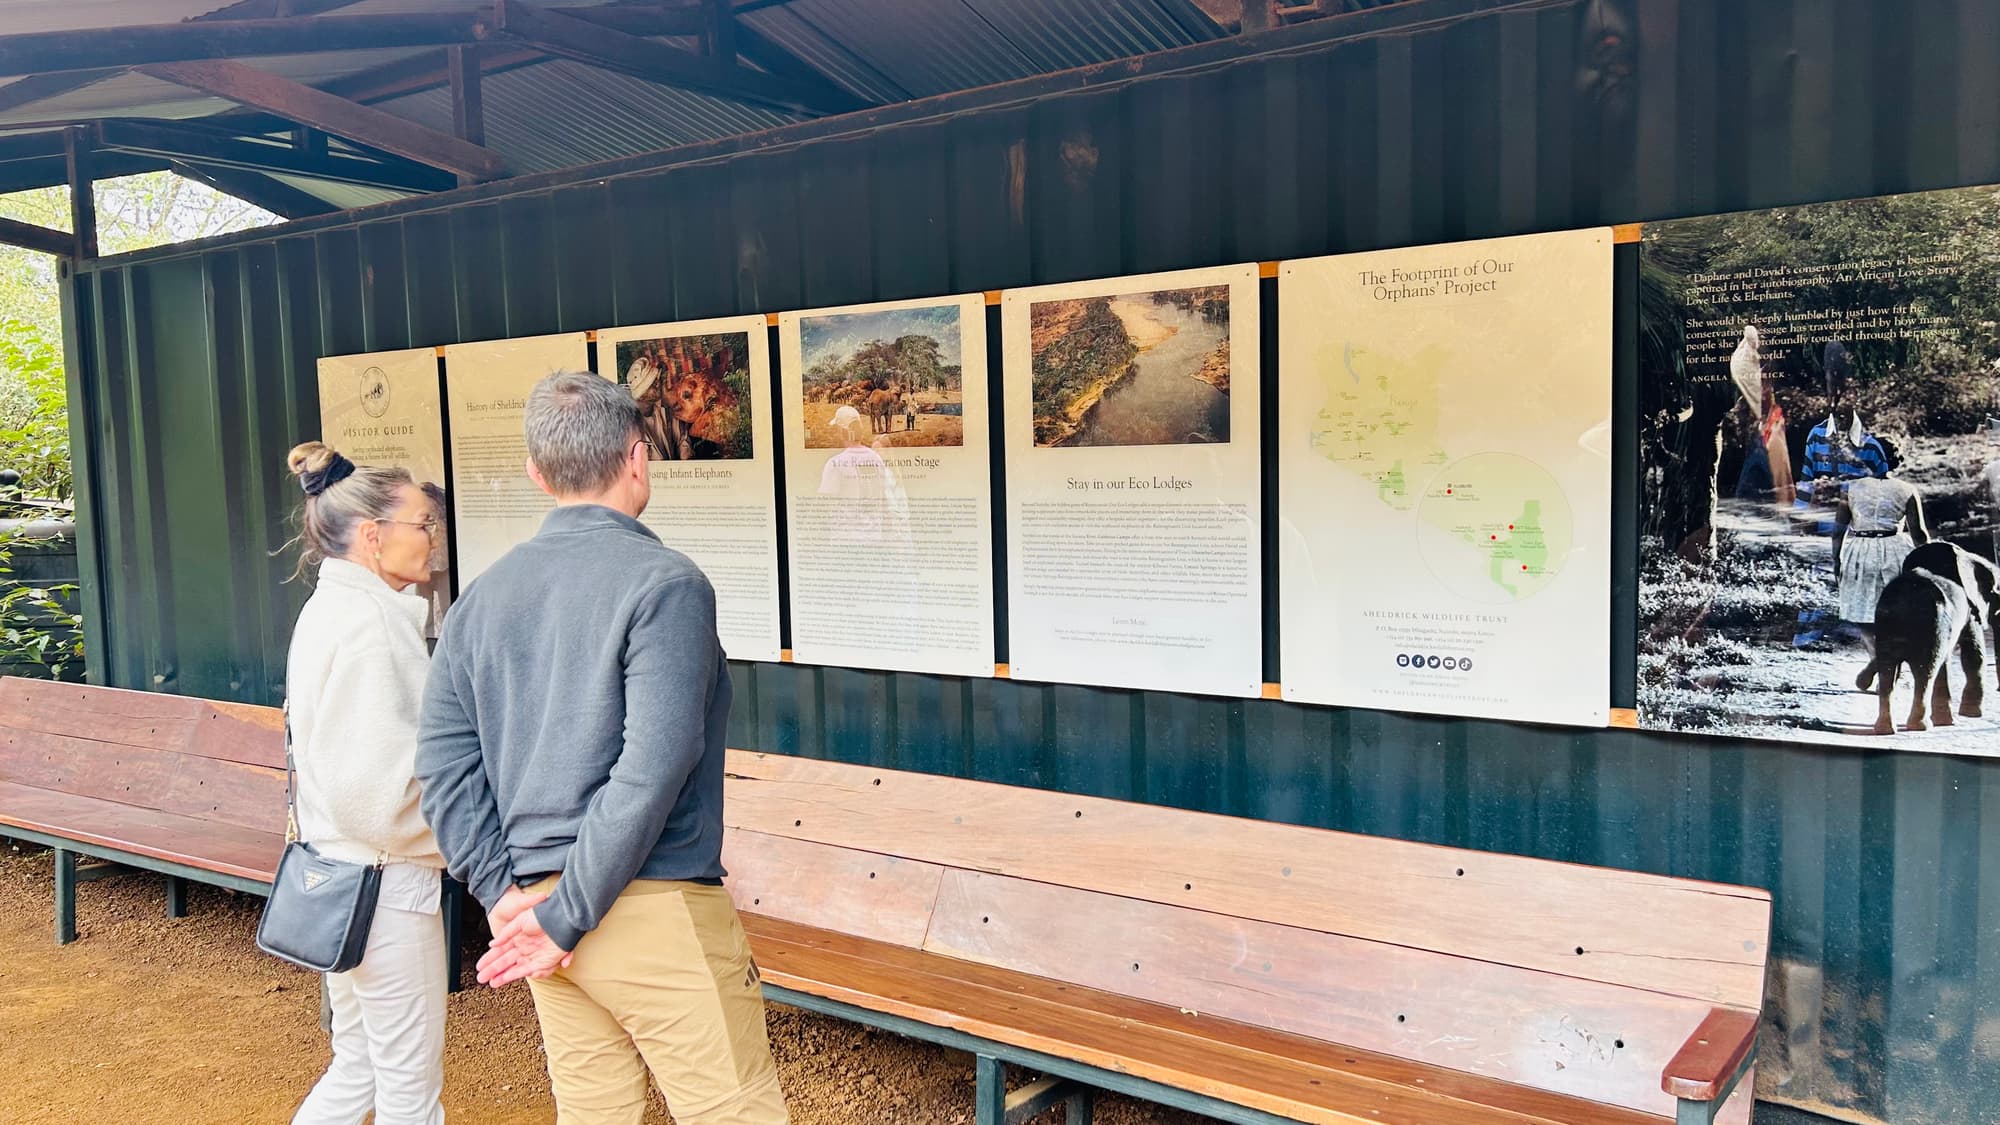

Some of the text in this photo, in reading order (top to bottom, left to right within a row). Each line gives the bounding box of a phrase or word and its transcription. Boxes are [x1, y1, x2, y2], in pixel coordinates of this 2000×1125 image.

[1359, 259, 1514, 286] The Footprint of Our
[1694, 271, 1731, 283] Daphne
[1733, 269, 1752, 279] and
[1754, 265, 1791, 278] David's
[1793, 262, 1858, 274] conservation
[1861, 258, 1893, 270] legacy
[1908, 250, 1963, 264] beautifully
[1374, 280, 1497, 302] Orphans' Project
[1686, 283, 1727, 296] captured
[1730, 283, 1739, 291] in
[1742, 281, 1758, 290] her
[1836, 273, 1852, 281] An
[1855, 271, 1895, 281] African
[1898, 268, 1924, 277] Love
[1686, 290, 1796, 306] Love Life & Elephants.
[1686, 303, 1928, 328] She would be deeply humbled by just how far her
[1686, 316, 1949, 340] conservation essage has travelled and by how many
[1686, 340, 1716, 352] people
[1718, 338, 1734, 348] she
[1810, 331, 1853, 342] touched
[1855, 328, 1897, 340] through
[1920, 326, 1960, 339] passion
[1686, 355, 1699, 364] for
[1701, 353, 1716, 363] the
[1691, 374, 1728, 383] ANGELA
[343, 425, 414, 437] VISITOR GUIDE
[915, 455, 940, 469] Stage
[670, 468, 692, 478] Infant
[694, 466, 732, 480] Elephants
[1067, 475, 1193, 492] Stay in our Eco Lodges
